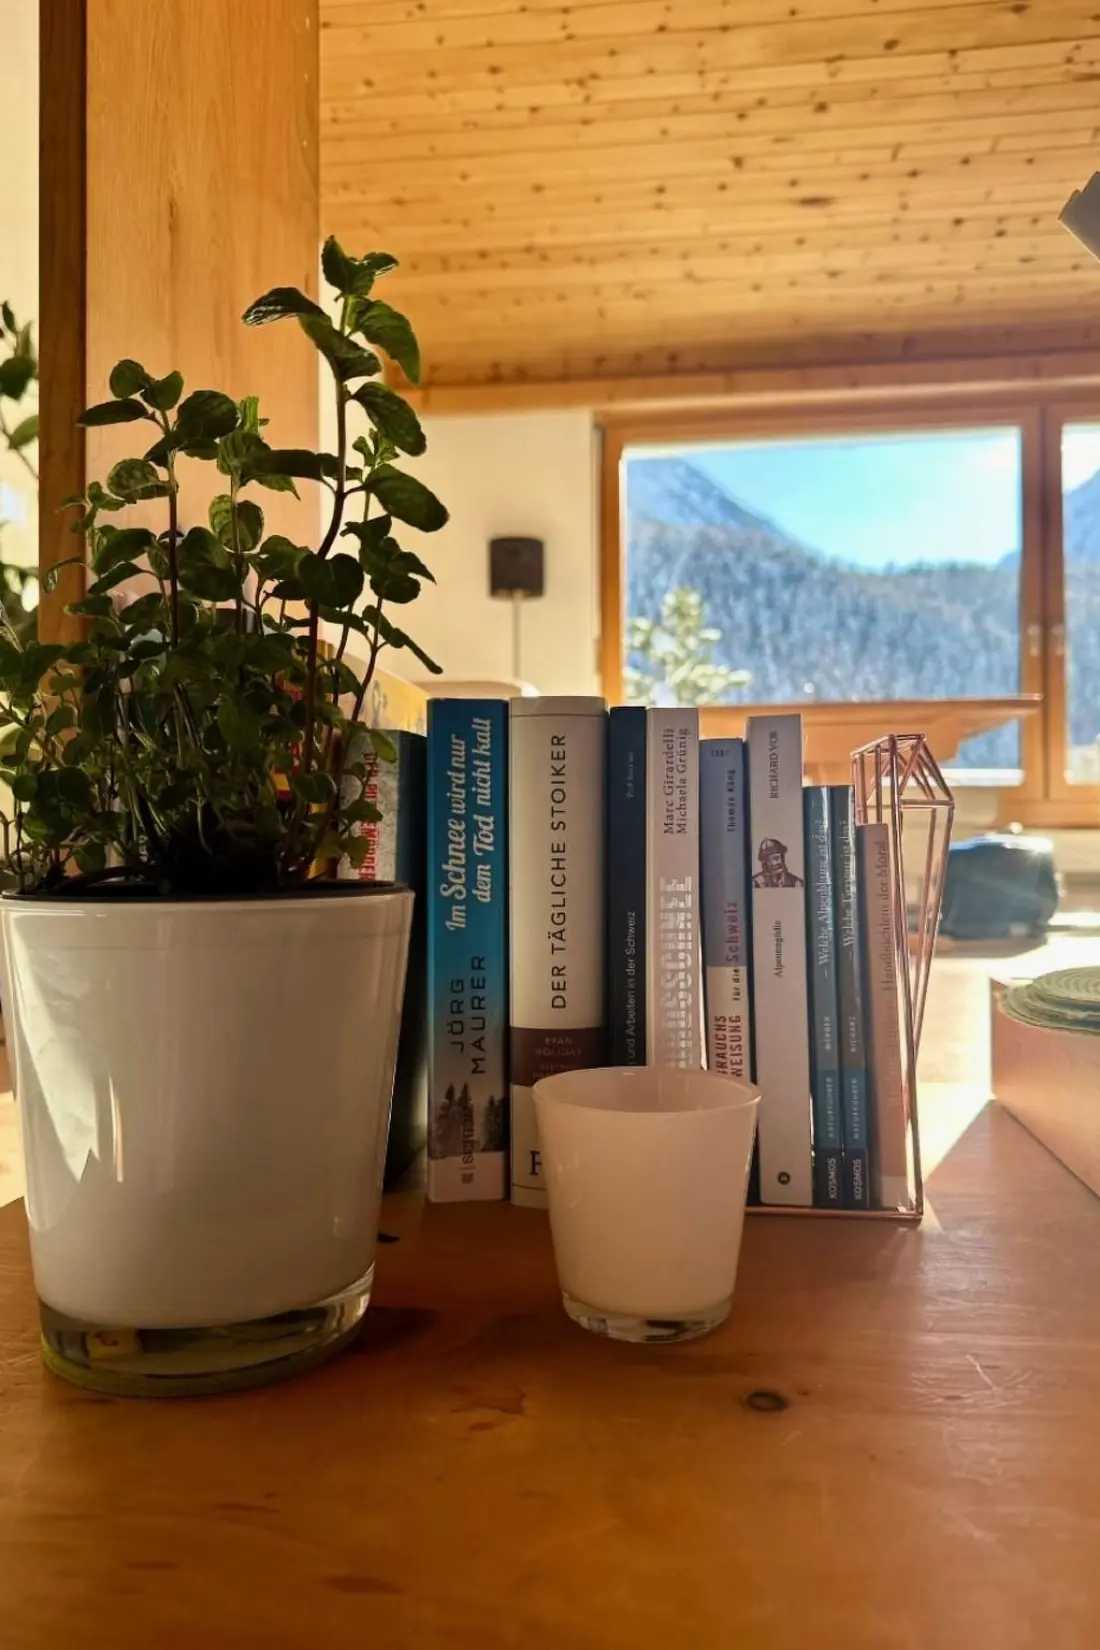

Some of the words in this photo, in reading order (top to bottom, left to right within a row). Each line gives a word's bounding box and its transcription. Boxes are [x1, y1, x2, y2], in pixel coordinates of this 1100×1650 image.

[450, 734, 466, 769] nur
[471, 717, 492, 757] kalt
[675, 728, 690, 775] Grünig
[470, 760, 492, 807] nicht
[550, 734, 567, 832] STOIKER
[662, 728, 675, 797] Girardelli
[768, 753, 779, 800] RICHARD
[446, 770, 467, 814] wird
[675, 778, 688, 835] Michaela
[472, 813, 495, 856] Tod
[663, 801, 675, 835] Marc
[726, 796, 737, 834] Thomas
[440, 818, 467, 900] Schnee
[471, 864, 492, 903] dem
[547, 841, 567, 955] TÄGLICHE
[876, 882, 890, 901] der
[445, 905, 466, 931] Im
[624, 910, 636, 956] Schweiz
[723, 901, 741, 962] Schweiz
[842, 908, 855, 947] Welche
[550, 965, 567, 1010] DER
[625, 958, 636, 977] der
[625, 979, 636, 989] in
[730, 968, 741, 984] die
[470, 955, 487, 1075] MAURER
[625, 990, 636, 1037] Arbeiten
[731, 986, 741, 1001] für
[446, 977, 465, 1054] JÖRG
[626, 1039, 636, 1059] und
[827, 1157, 838, 1200] KOSMOS
[852, 1158, 864, 1201] KOSMOS
